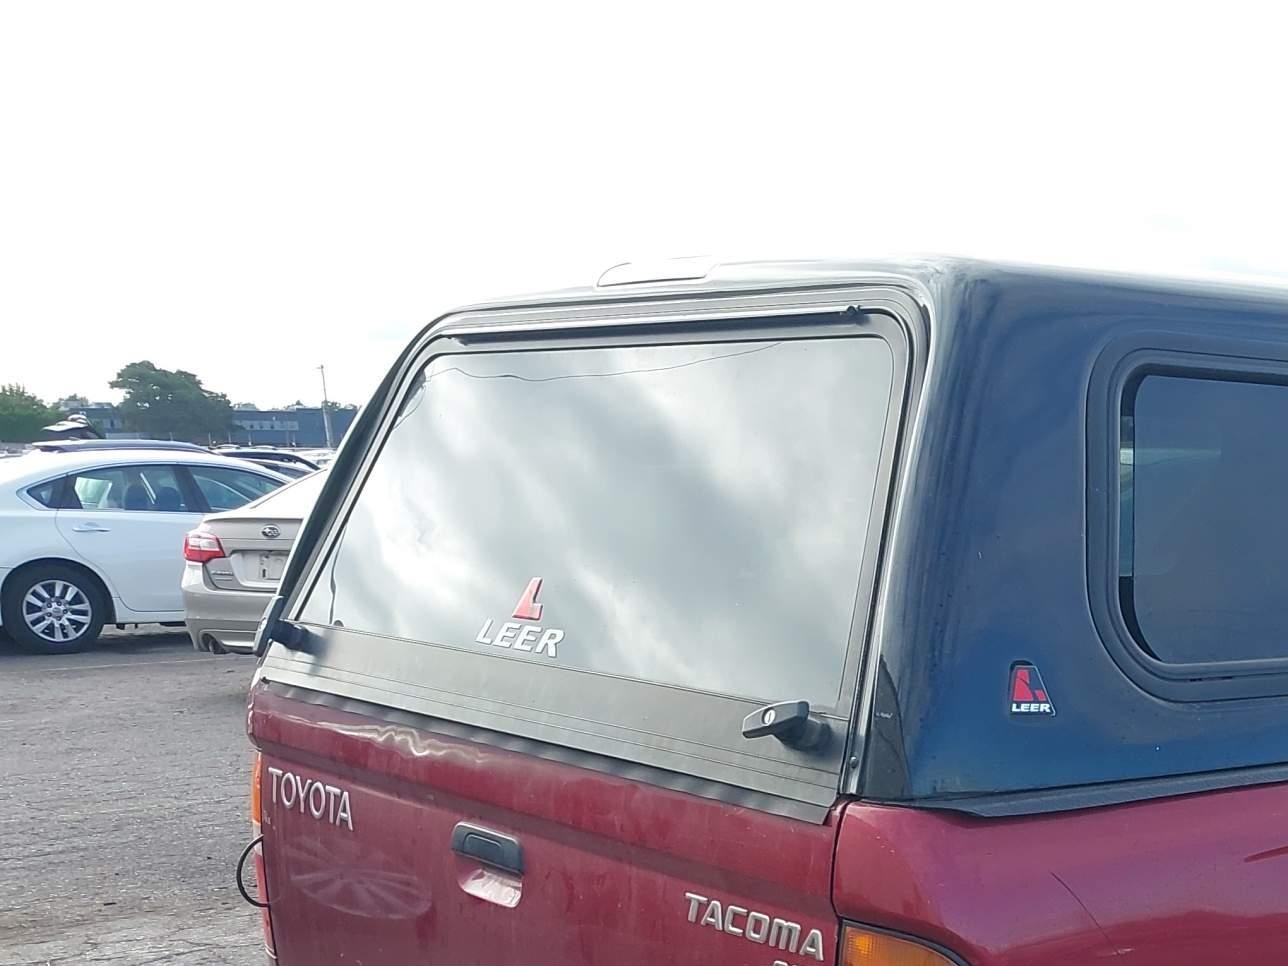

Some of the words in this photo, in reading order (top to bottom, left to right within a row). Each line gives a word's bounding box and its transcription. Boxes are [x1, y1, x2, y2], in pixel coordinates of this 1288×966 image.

[475, 617, 565, 658] LEER
[1011, 703, 1051, 713] LEER
[268, 766, 354, 831] TOYOTA
[684, 892, 824, 961] TACOMA
